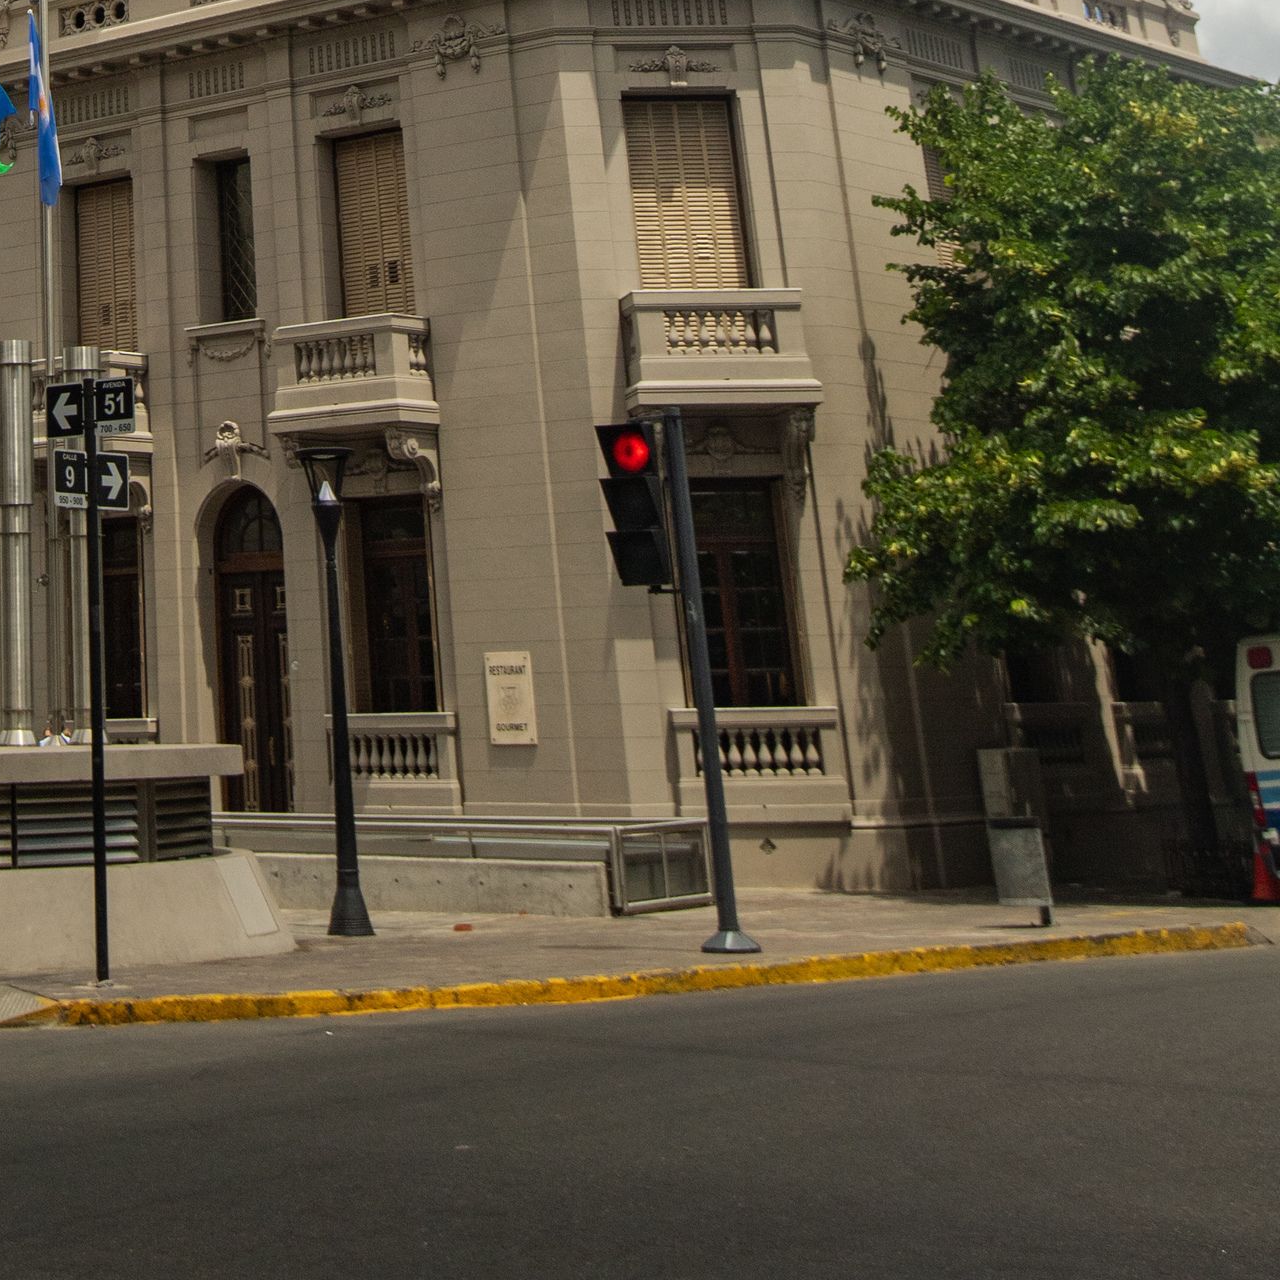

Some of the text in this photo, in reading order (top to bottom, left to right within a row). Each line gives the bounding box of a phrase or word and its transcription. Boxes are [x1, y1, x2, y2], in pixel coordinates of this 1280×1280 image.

[102, 381, 126, 389] AVENIDA
[104, 392, 124, 415] 51
[100, 424, 112, 433] 700
[118, 423, 131, 432] 650
[63, 453, 77, 461] CALLE
[65, 465, 75, 488] 9
[59, 496, 68, 504] 950
[73, 496, 83, 505] 900
[488, 665, 526, 675] RESTAURANT
[496, 723, 528, 732] GOURMET
